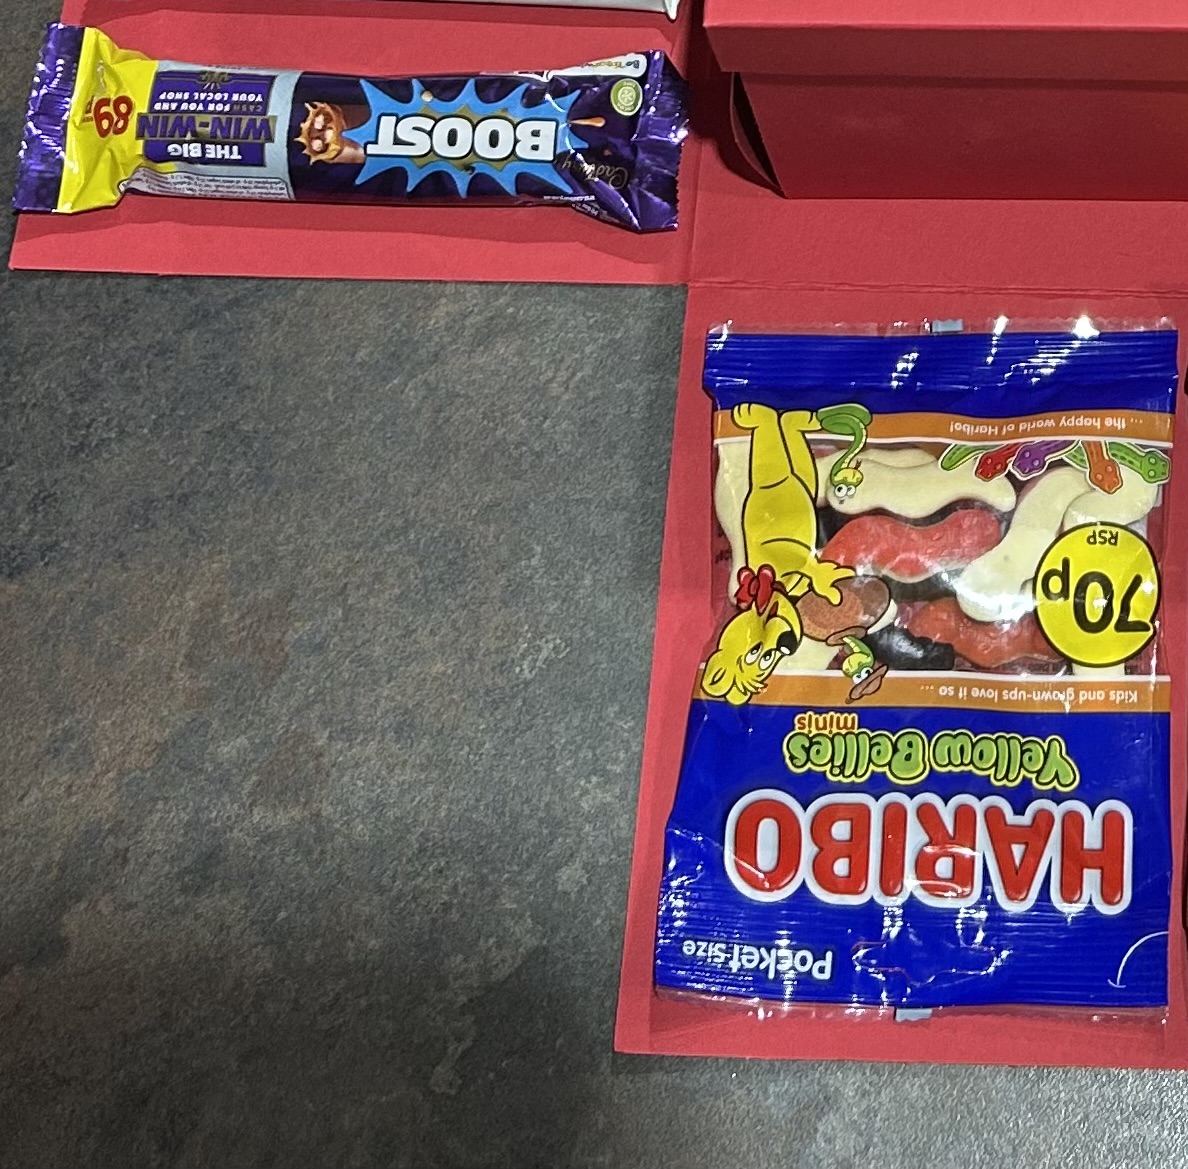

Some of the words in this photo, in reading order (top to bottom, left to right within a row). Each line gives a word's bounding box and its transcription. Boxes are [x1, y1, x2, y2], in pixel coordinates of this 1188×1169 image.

[159, 91, 190, 100] SHOP
[193, 92, 229, 101] LOCAL
[232, 93, 264, 102] YOUR
[154, 102, 177, 111] AND
[181, 103, 204, 111] YOU
[207, 103, 230, 112] FOR
[138, 116, 273, 140] WIN-WIN
[367, 116, 556, 162] BOOST
[168, 143, 201, 159] BIG
[206, 143, 242, 159] THE
[949, 421, 998, 437] Haribo!
[1000, 421, 1015, 434] of
[1018, 418, 1055, 434] world
[1059, 414, 1102, 433] happy
[1104, 416, 1126, 431] the
[1086, 530, 1119, 546] RSP
[1041, 557, 1152, 633] 70p
[938, 685, 955, 698] so
[956, 686, 969, 700] it
[970, 686, 998, 701] love
[1000, 687, 1081, 705] grown-ups
[1083, 688, 1108, 703] and
[1112, 688, 1137, 703] Kids
[796, 714, 857, 733] minis
[786, 730, 926, 782] Bellies
[932, 732, 1077, 790] Yellow
[731, 797, 1128, 908] HARIBO
